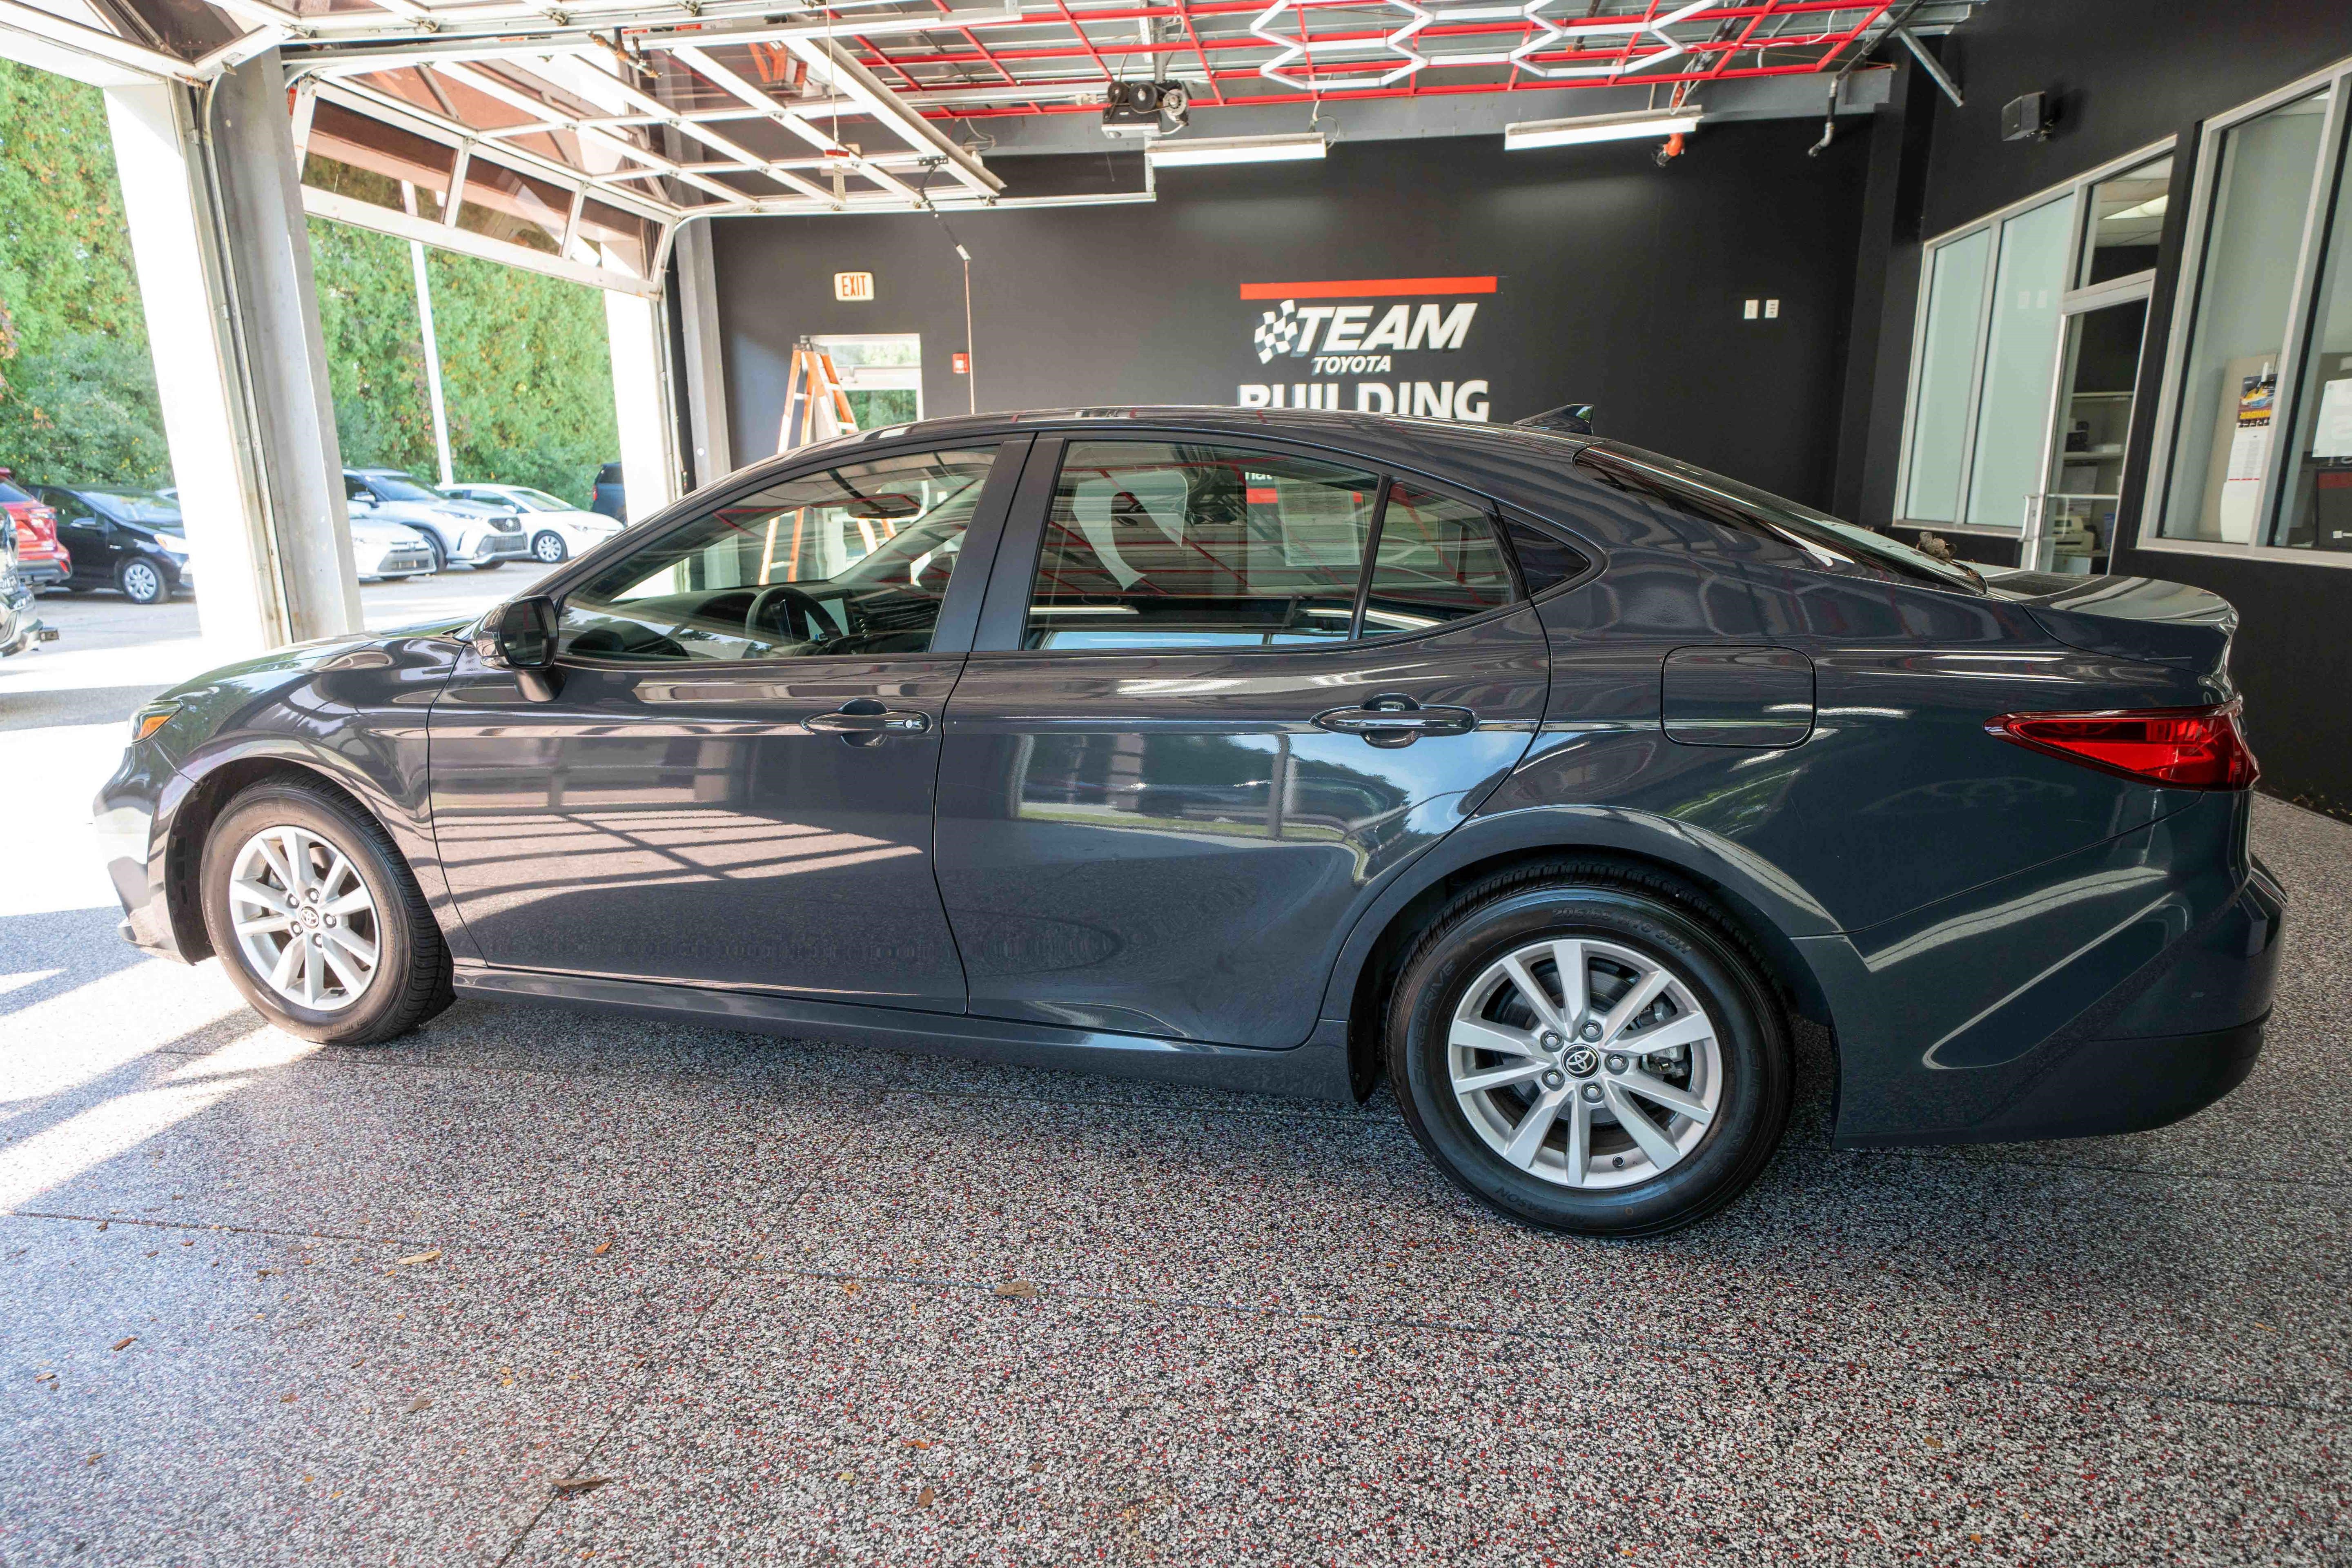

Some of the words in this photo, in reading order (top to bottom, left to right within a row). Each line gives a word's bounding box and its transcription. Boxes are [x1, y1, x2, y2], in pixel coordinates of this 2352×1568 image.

[841, 275, 866, 296] EXIT
[1295, 303, 1478, 352] TEAM
[1312, 355, 1391, 374] TOYOTA
[1552, 907, 1612, 921] 205/65
